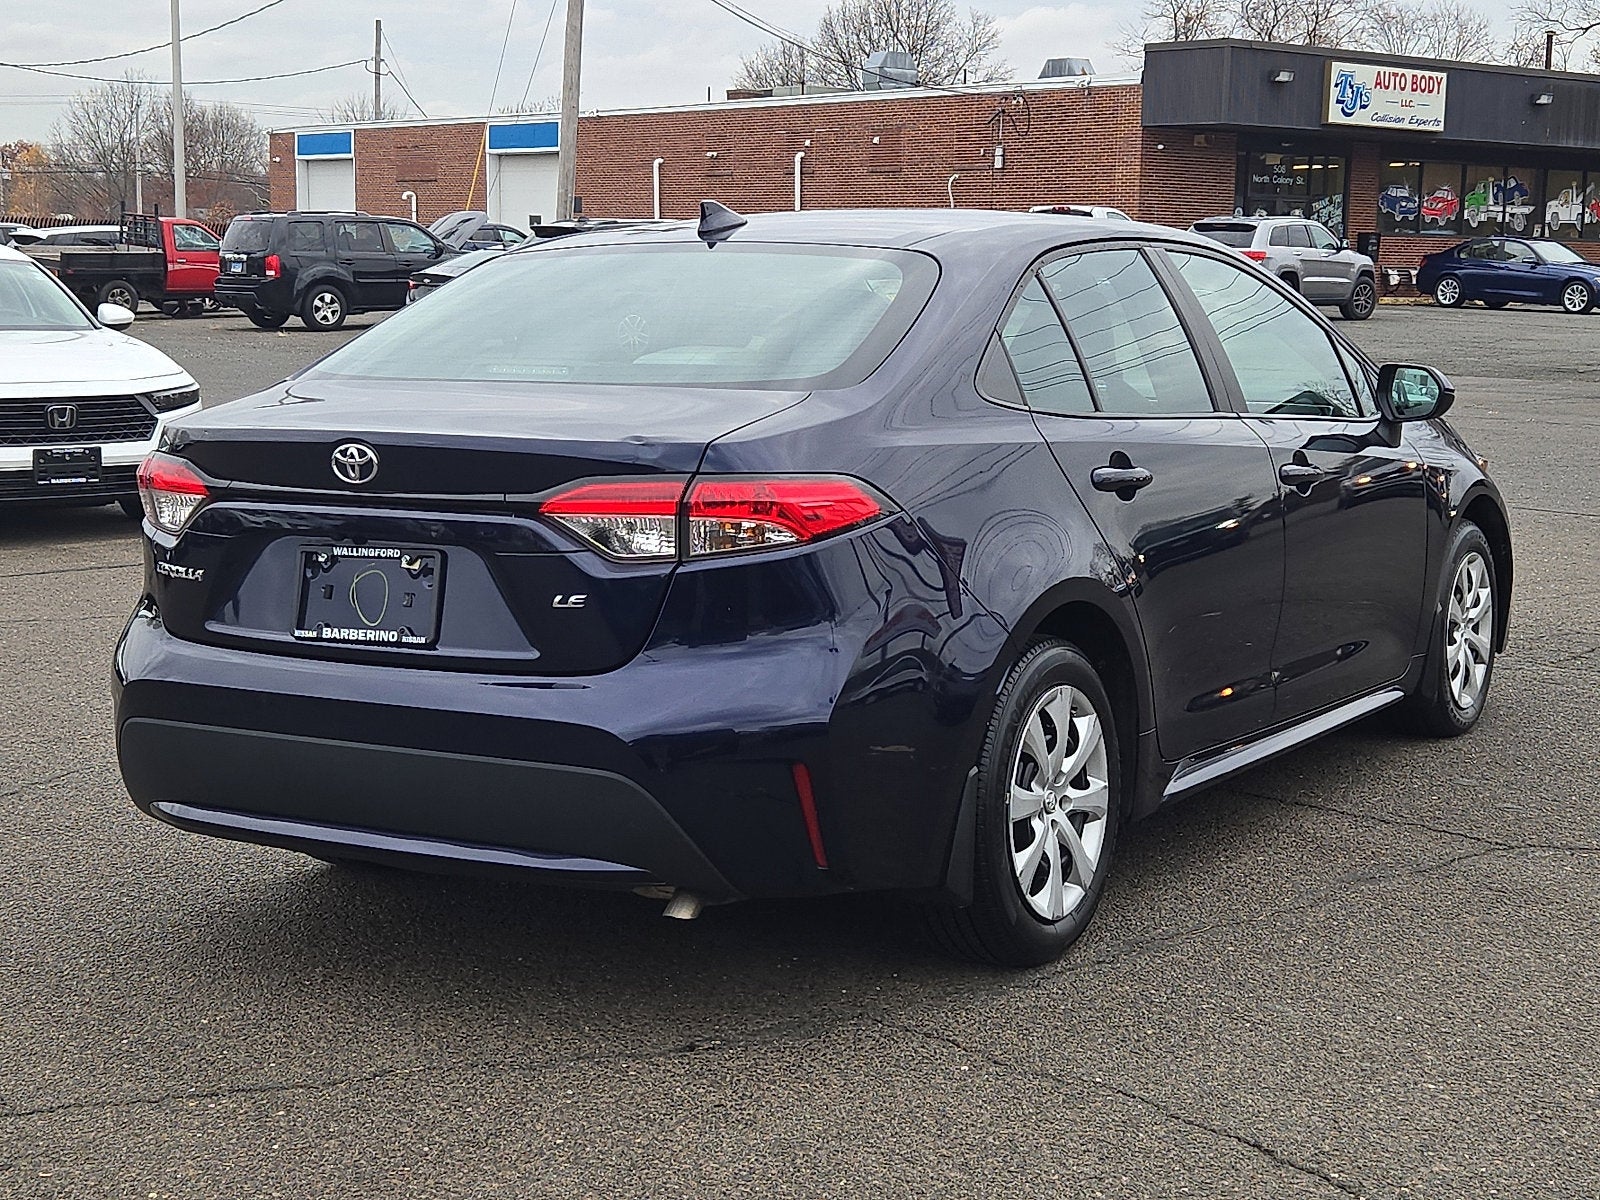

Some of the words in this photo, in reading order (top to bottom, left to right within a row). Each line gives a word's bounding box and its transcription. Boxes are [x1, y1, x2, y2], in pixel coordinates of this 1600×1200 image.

[1374, 70, 1408, 91] AUTO
[1411, 74, 1444, 95] BODY
[1370, 112, 1406, 124] Collision
[1408, 115, 1442, 127] Experts
[1252, 174, 1270, 183] North
[1272, 175, 1294, 186] Colony
[332, 546, 401, 558] WALLINGFORD
[552, 594, 588, 608] LE
[322, 627, 399, 642] BARBERINO
